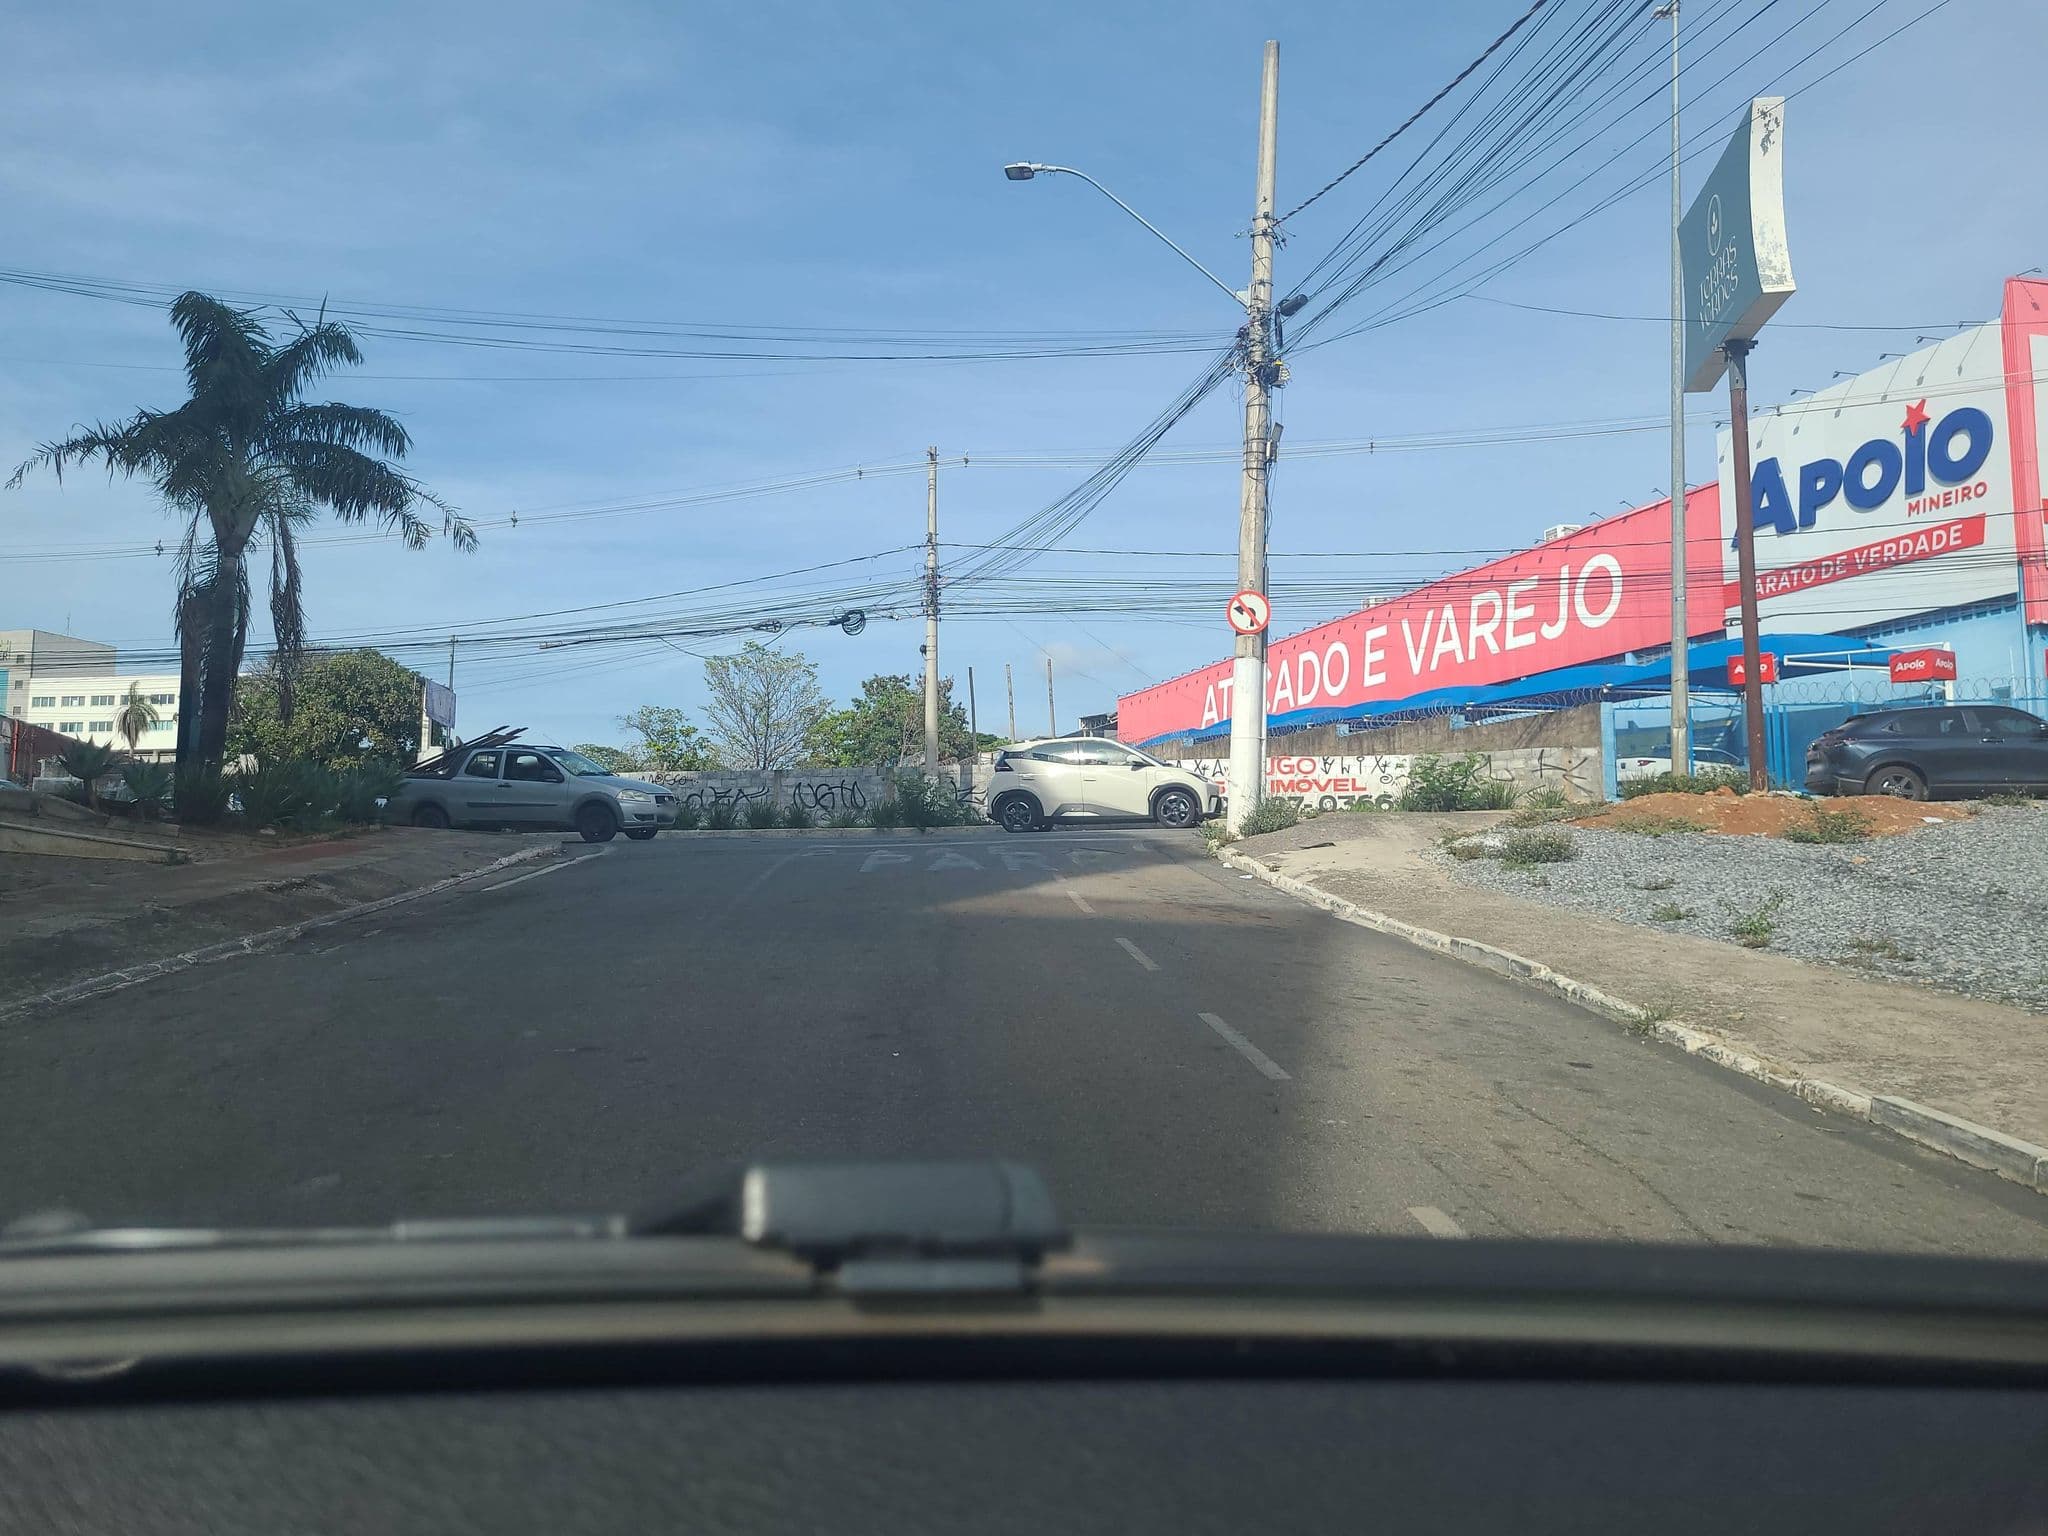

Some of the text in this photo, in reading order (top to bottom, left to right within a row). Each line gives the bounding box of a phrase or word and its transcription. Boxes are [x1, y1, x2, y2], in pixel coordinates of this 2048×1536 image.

[1907, 481, 1988, 518] MINEIRO
[1754, 524, 1964, 596] ARATO DE VERDADE
[1200, 552, 1623, 730] ATADO E VAREJO
